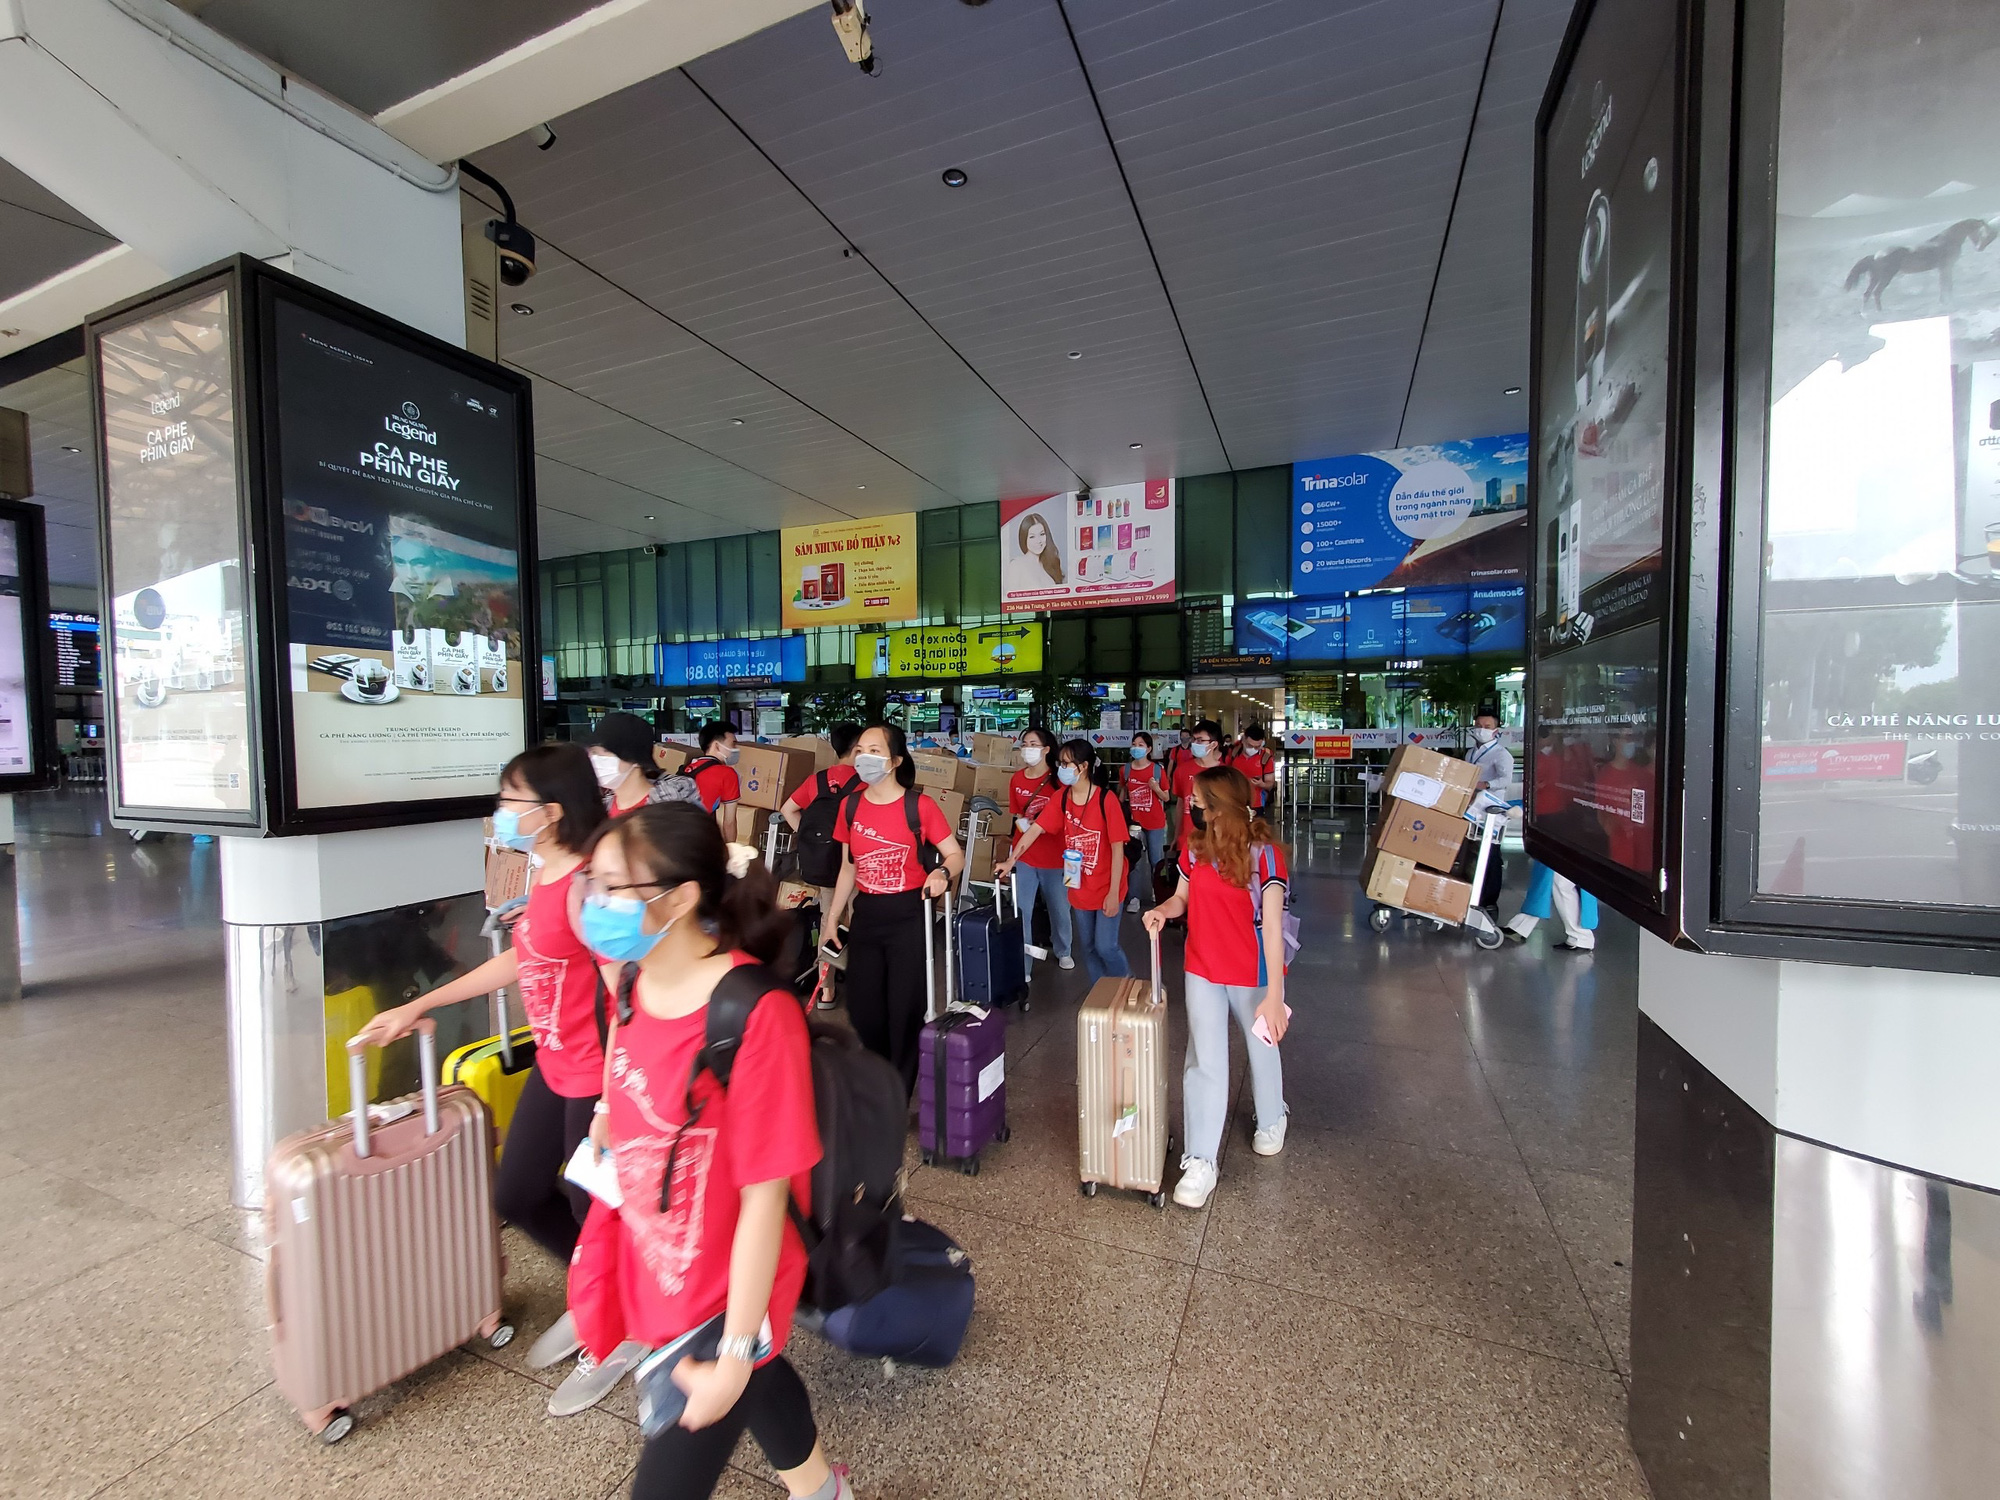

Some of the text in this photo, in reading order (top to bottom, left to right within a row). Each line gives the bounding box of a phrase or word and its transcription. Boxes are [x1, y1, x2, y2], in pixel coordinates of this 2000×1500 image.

[150, 392, 180, 415] Legend
[385, 416, 437, 445] Legend
[140, 444, 167, 464] PHIN
[360, 451, 412, 479] PHIN
[1301, 472, 1370, 492] Trinasolar
[1431, 487, 1447, 497] thế
[1395, 503, 1419, 511] trong
[1420, 499, 1447, 510] ngành
[815, 540, 844, 555] NHUNG
[846, 533, 859, 551] BỔ
[1316, 538, 1365, 548] 100+ Countries
[1326, 558, 1345, 566] World
[1345, 556, 1372, 564] Records
[1470, 567, 1519, 577] trinasolar.com
[1258, 656, 1272, 666] A2
[1827, 712, 1855, 727] CÀ
[1906, 712, 1968, 726] NĂNG
[1917, 732, 1973, 741] ENERGY
